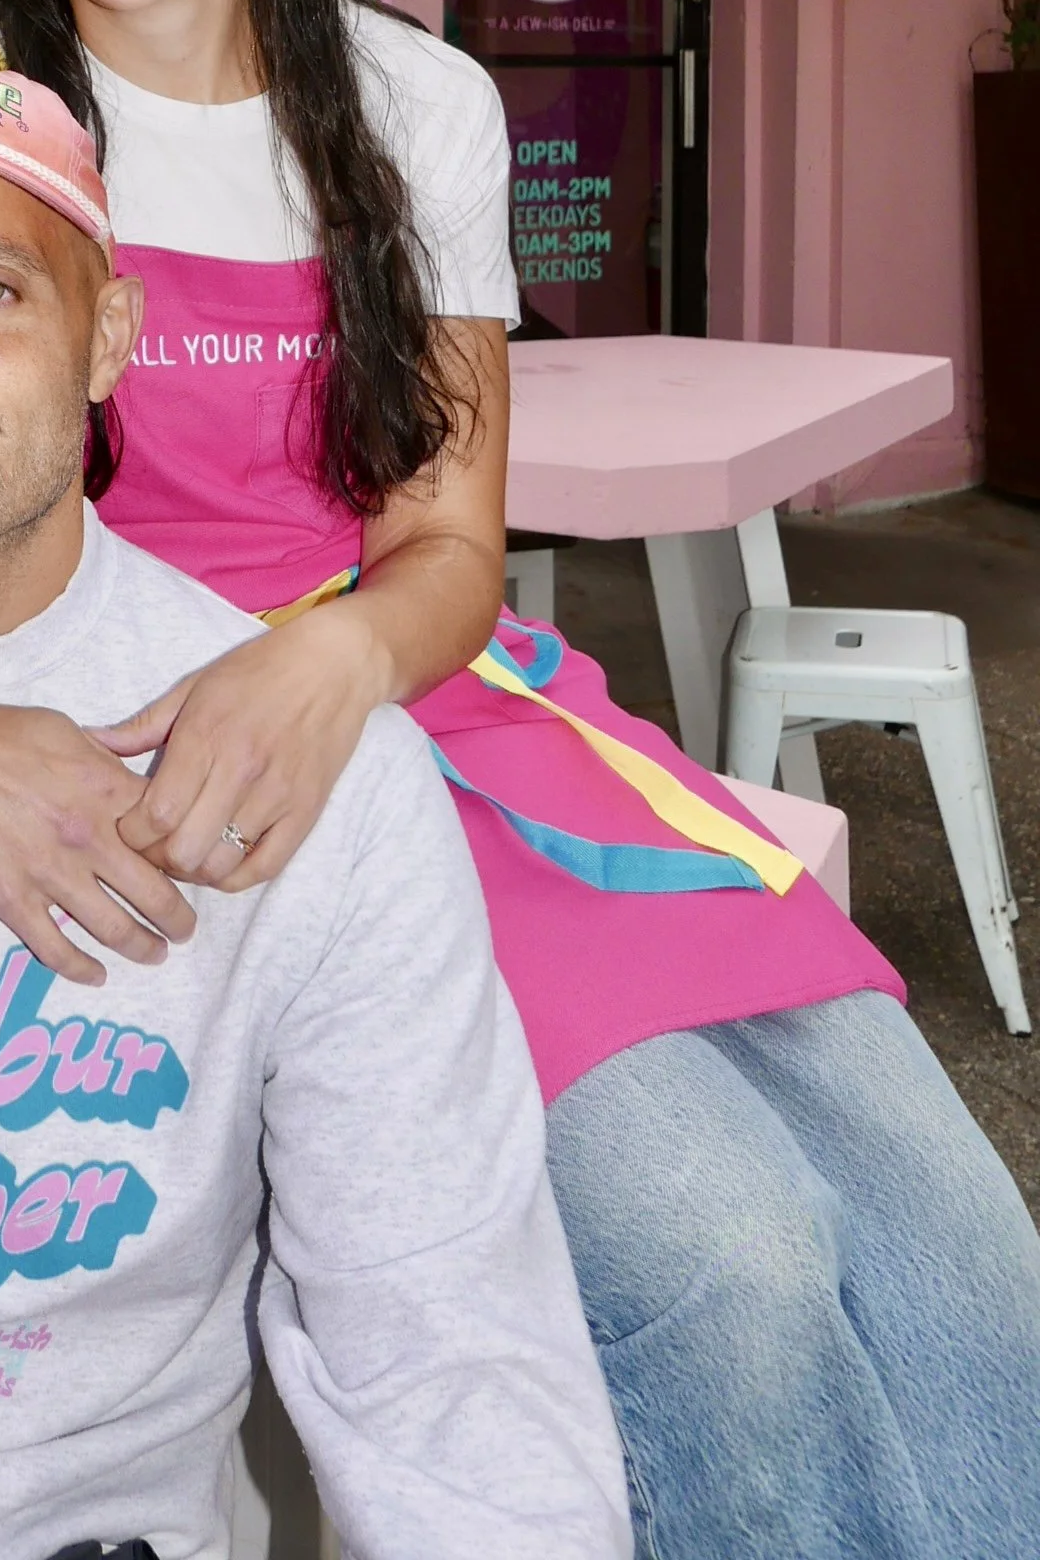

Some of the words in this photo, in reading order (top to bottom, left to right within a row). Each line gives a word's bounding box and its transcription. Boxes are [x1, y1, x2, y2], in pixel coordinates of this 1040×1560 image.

[573, 16, 602, 32] DELI
[516, 140, 578, 166] OPEN
[519, 257, 603, 284] EKENDS
[182, 333, 264, 365] YOUR
